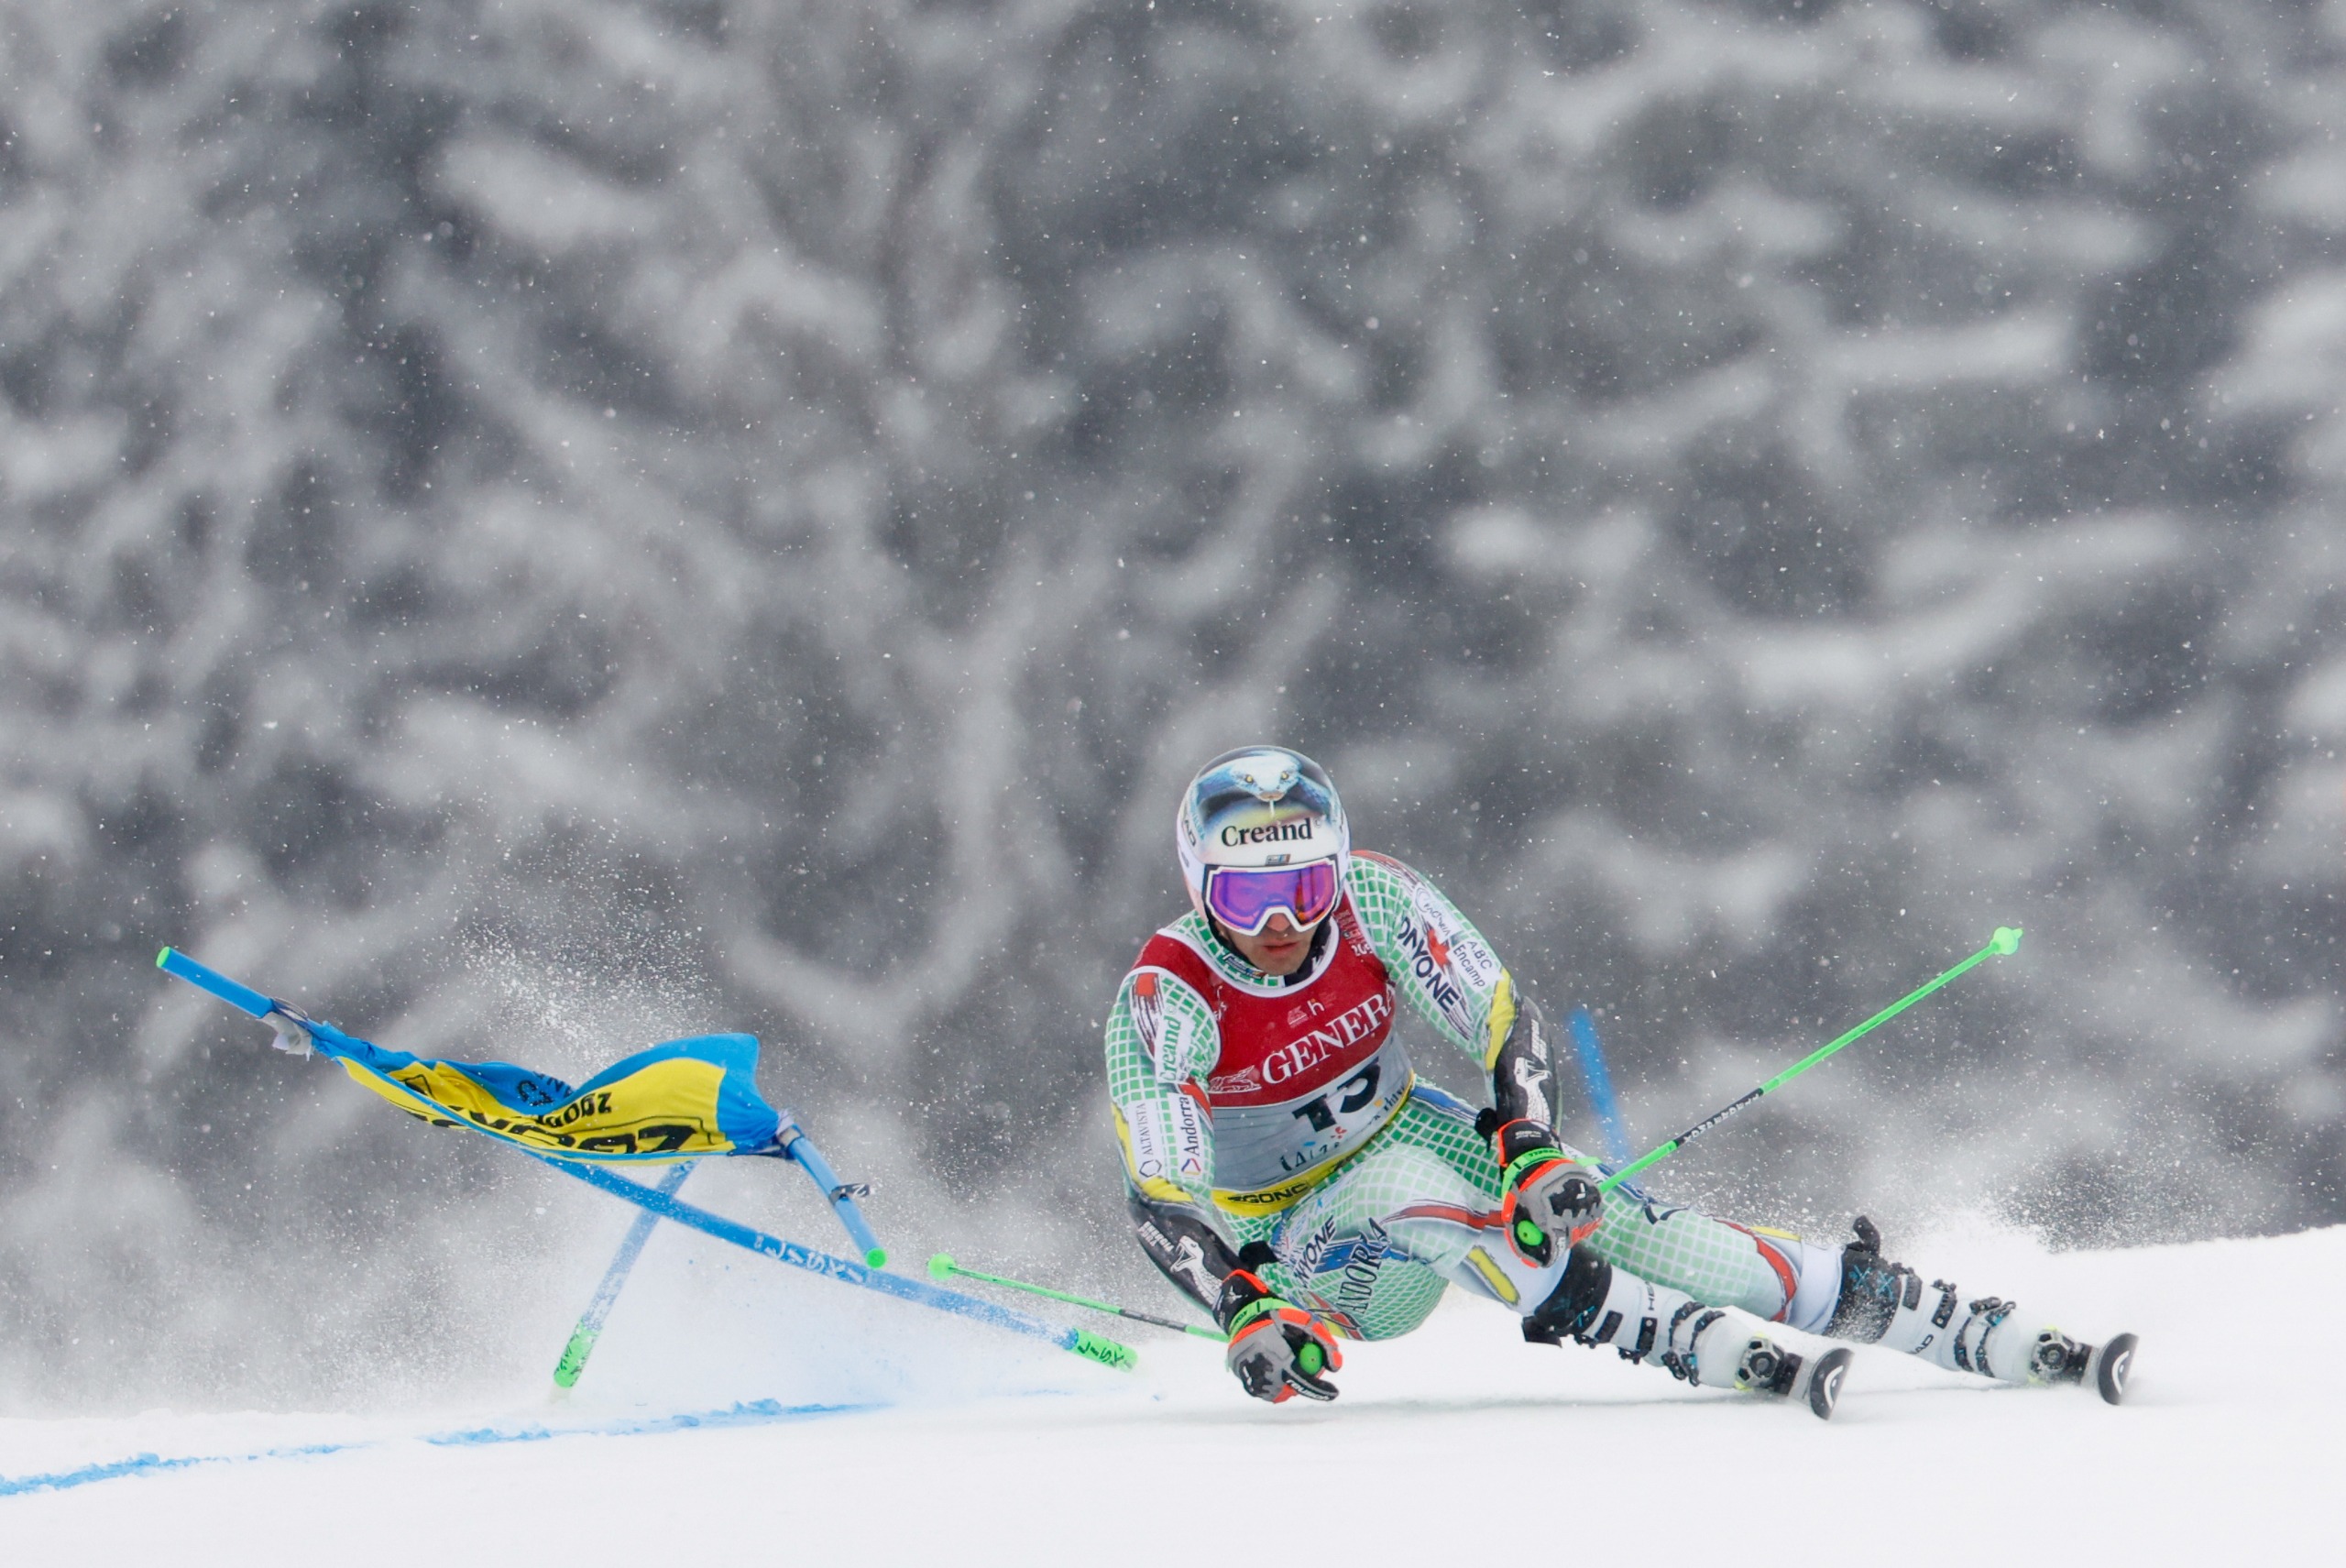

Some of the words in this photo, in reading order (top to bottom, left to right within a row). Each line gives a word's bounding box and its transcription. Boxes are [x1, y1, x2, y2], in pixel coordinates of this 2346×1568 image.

[1221, 817, 1313, 847] Creand
[1453, 944, 1485, 987] Encamp
[1159, 1015, 1181, 1083] Creand
[1135, 1102, 1153, 1156] ALTAVISTA
[1178, 1096, 1200, 1157] Andorra
